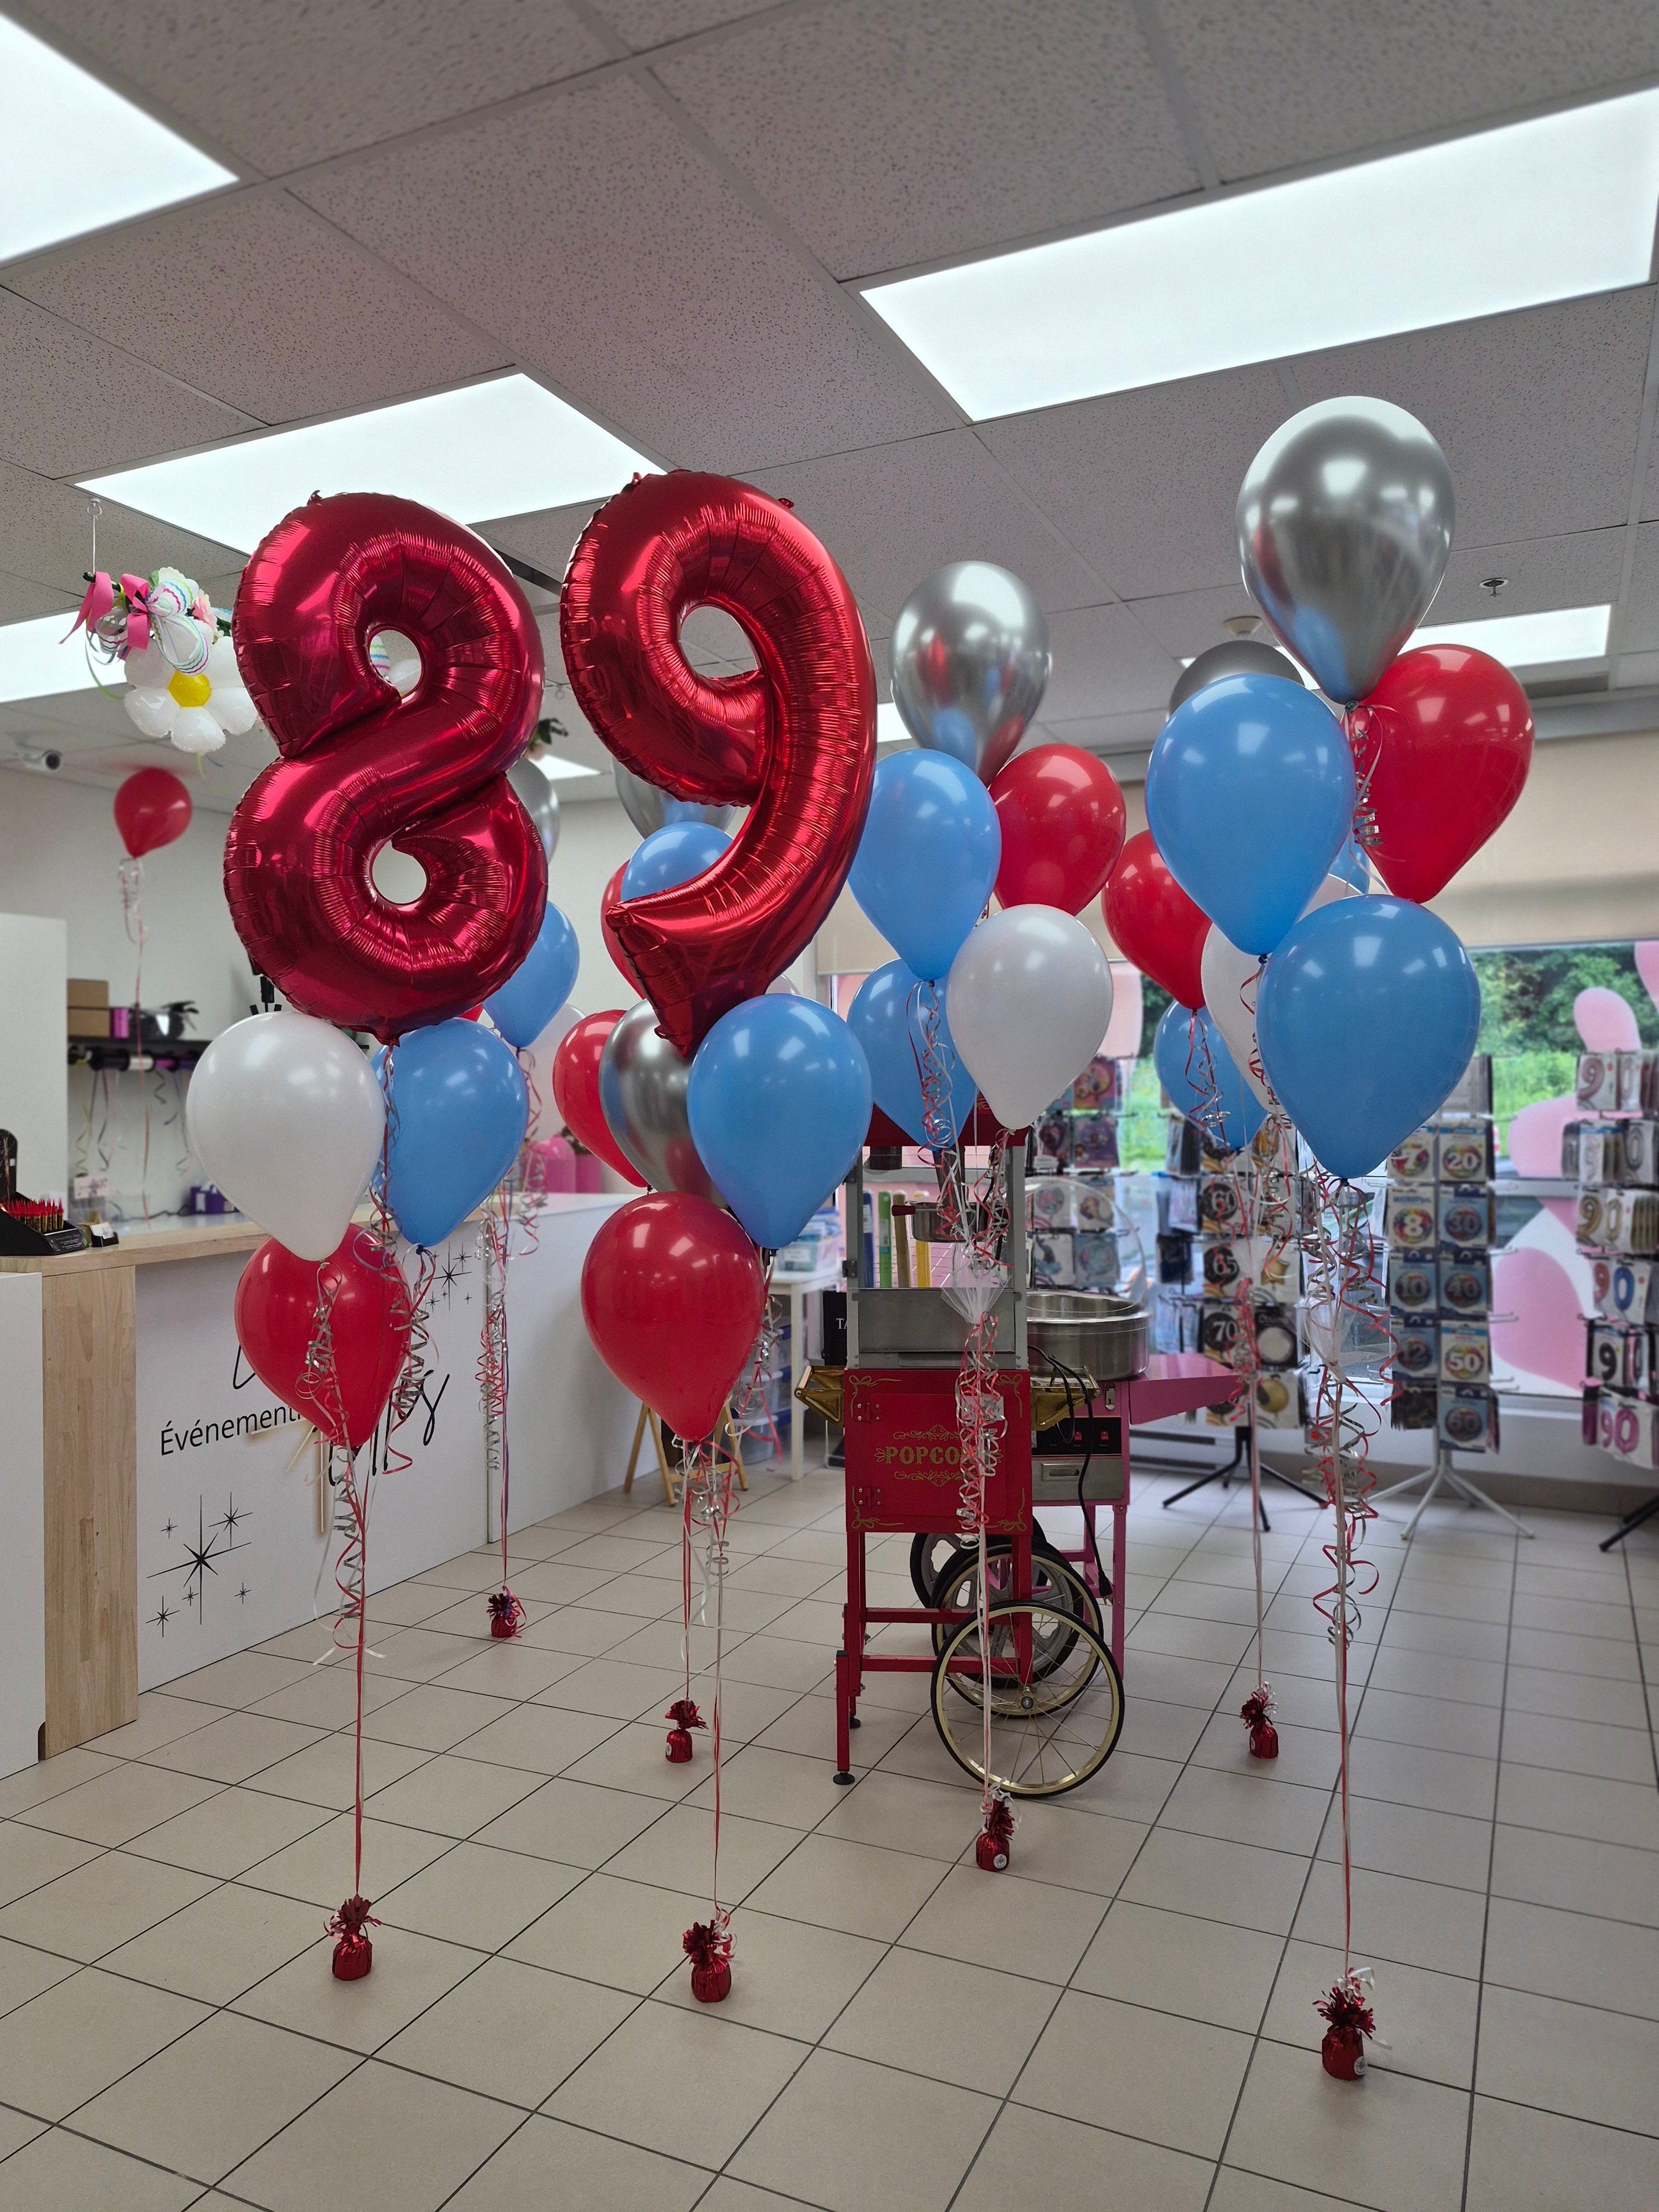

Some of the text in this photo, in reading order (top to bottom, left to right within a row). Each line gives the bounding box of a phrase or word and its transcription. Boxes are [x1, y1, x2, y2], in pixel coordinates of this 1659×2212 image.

[1447, 1152, 1478, 1170] 20
[1403, 1213, 1423, 1235] 8
[1448, 1353, 1480, 1371] 50
